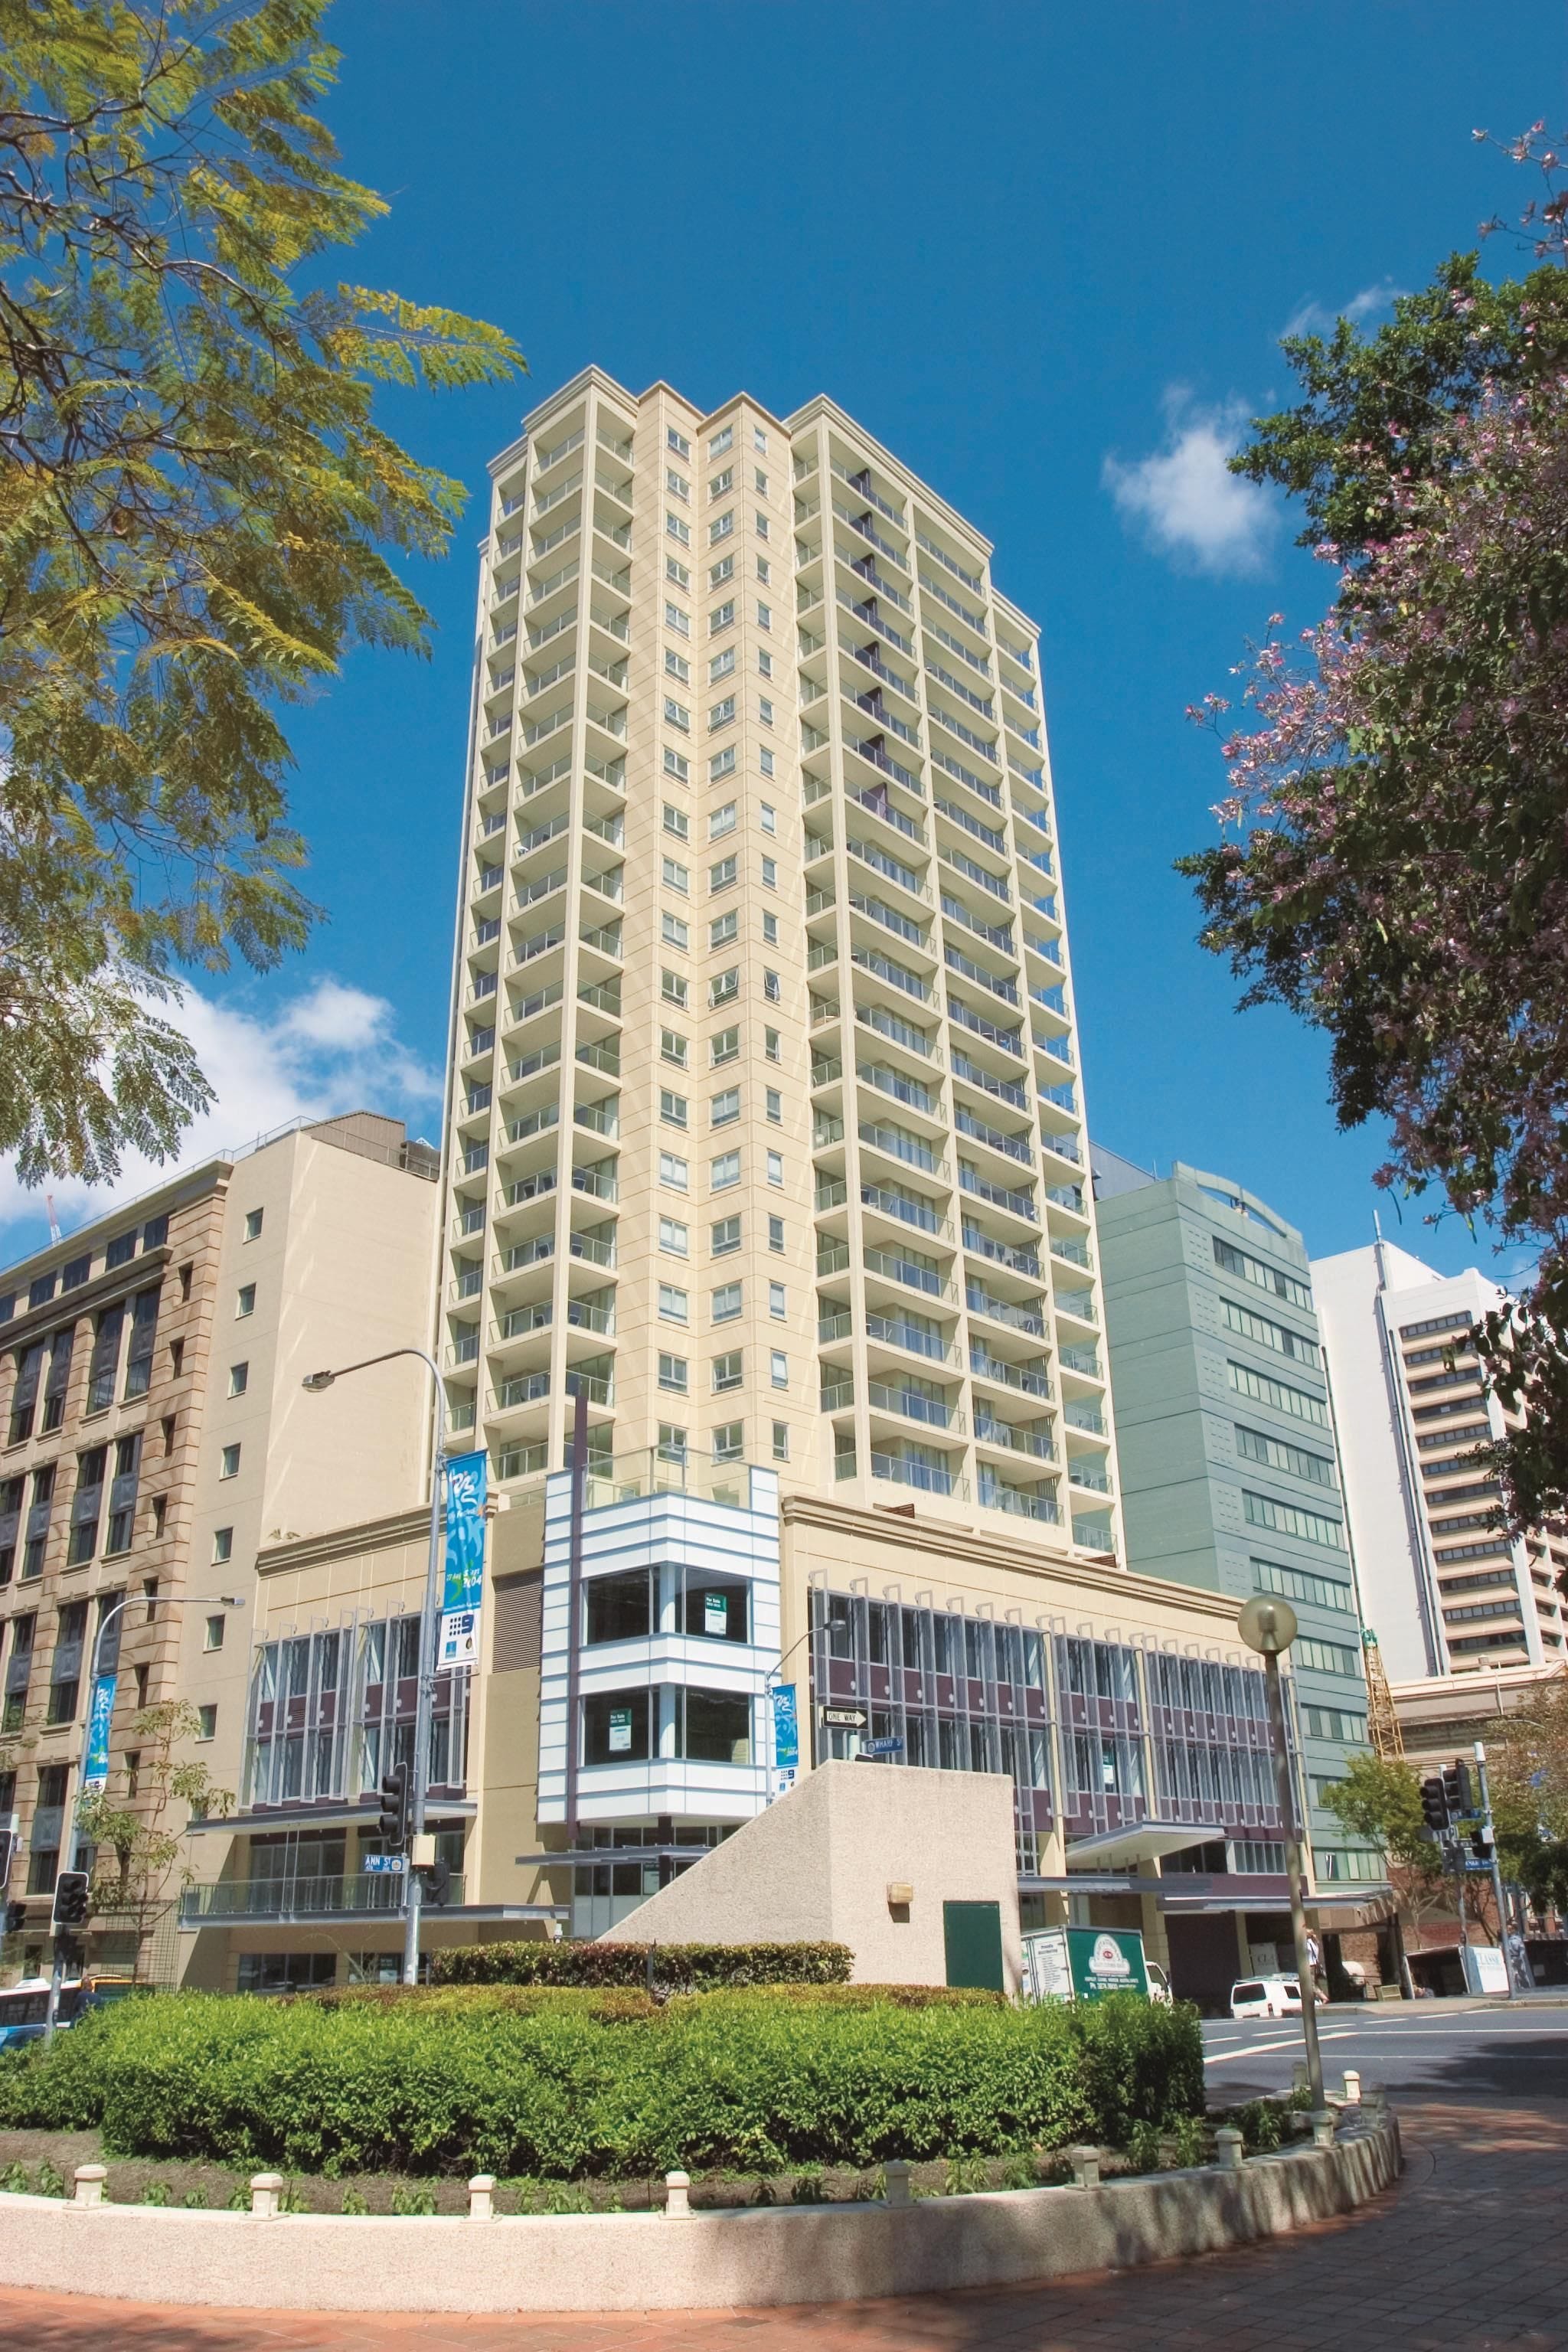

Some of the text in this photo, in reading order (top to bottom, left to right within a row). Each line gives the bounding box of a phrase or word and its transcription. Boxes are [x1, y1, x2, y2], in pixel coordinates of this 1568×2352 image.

[828, 1712, 856, 1722] ONE WAY
[875, 1740, 893, 1748] WHARF
[365, 1855, 390, 1866] ANN ST
